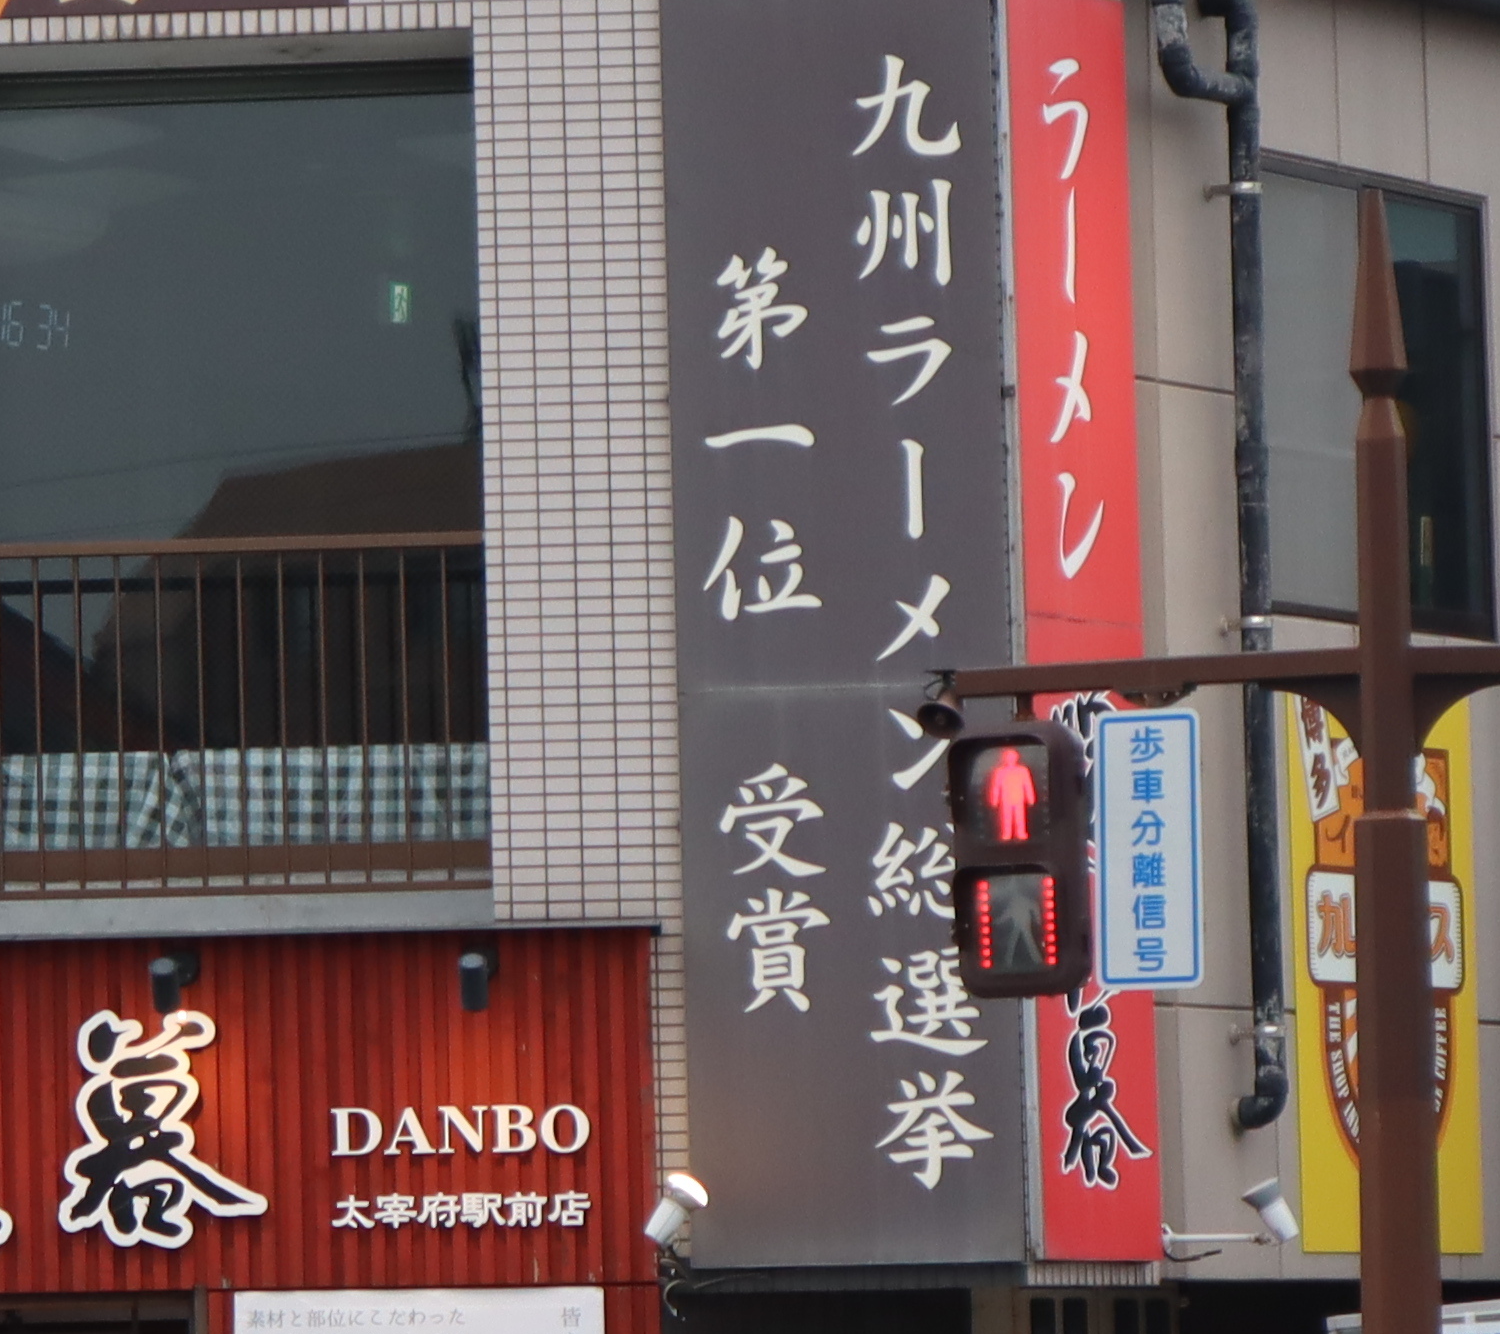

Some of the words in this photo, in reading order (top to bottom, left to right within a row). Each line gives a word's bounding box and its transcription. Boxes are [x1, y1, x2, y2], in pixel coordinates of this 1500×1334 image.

[1042, 58, 1106, 580] ラーメン
[849, 54, 994, 1191] 九州ラーメン総選挙
[1129, 725, 1168, 973] 歩車分離信号
[330, 1104, 592, 1160] DANBO
[331, 1190, 593, 1233] 太宰府駅前店
[246, 1308, 467, 1329] 素材と部位にこだわった
